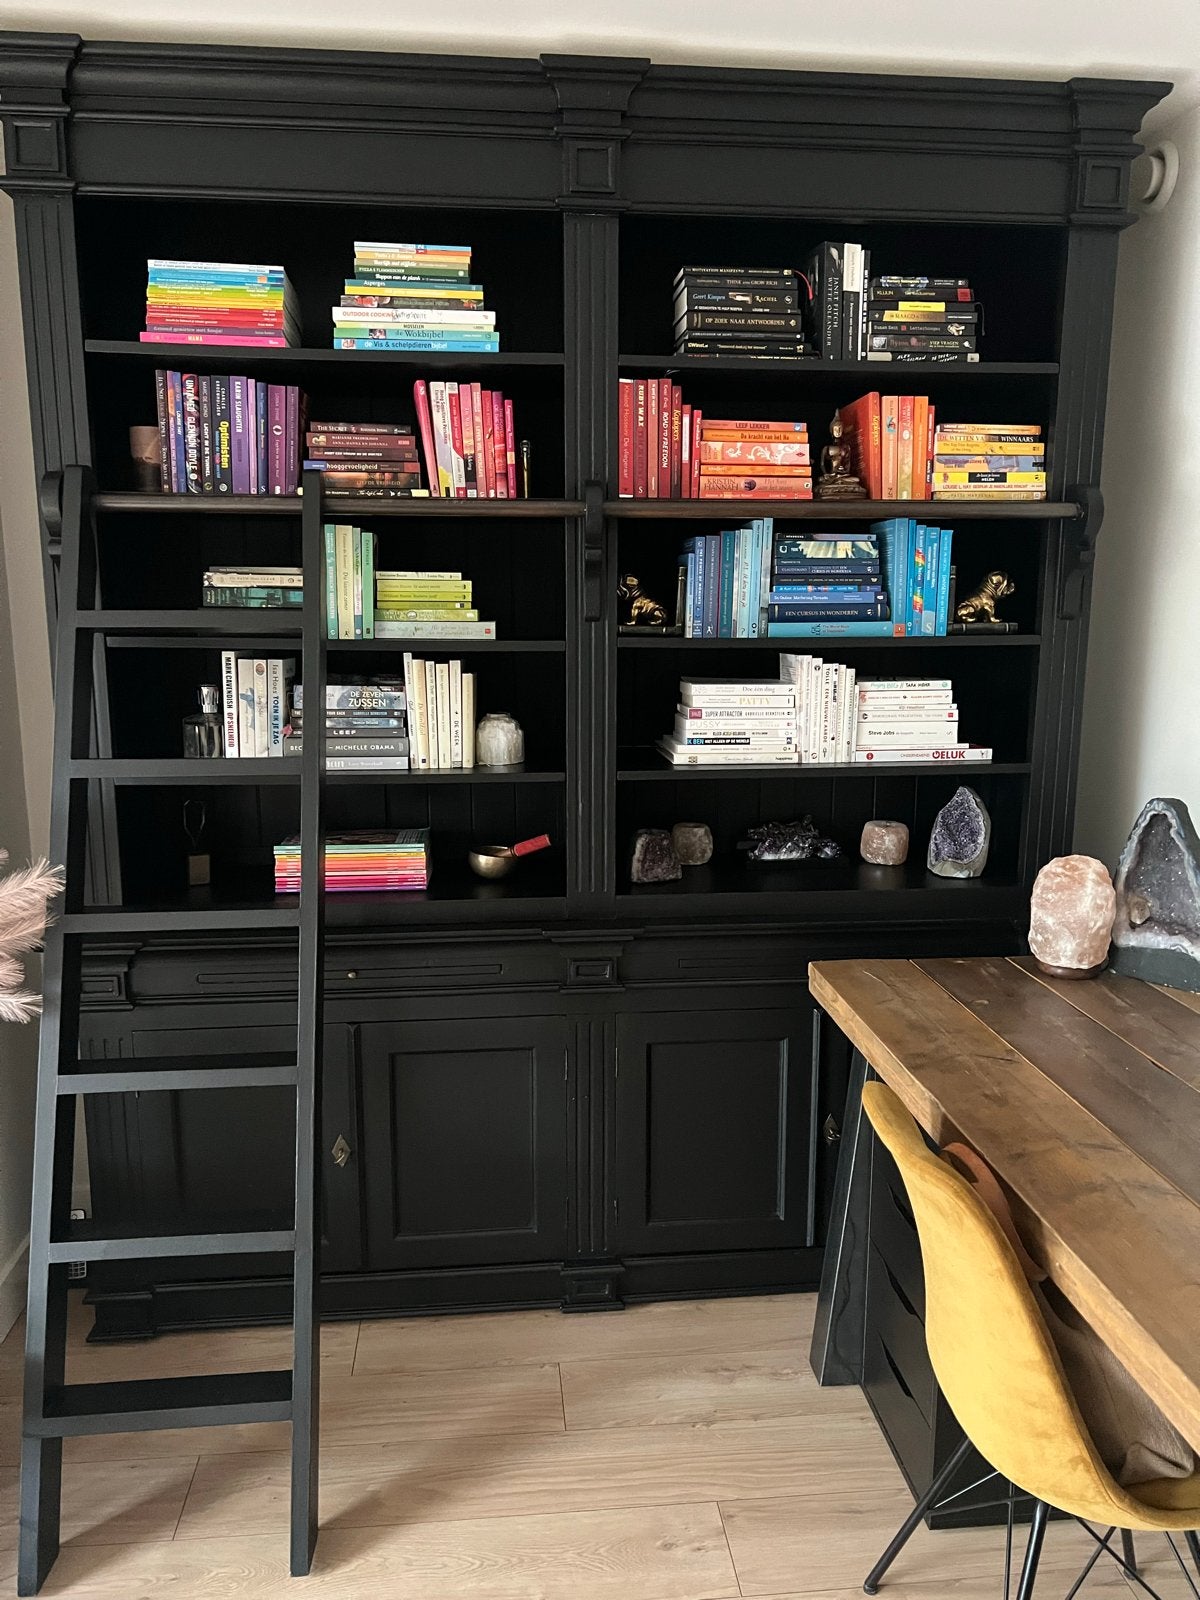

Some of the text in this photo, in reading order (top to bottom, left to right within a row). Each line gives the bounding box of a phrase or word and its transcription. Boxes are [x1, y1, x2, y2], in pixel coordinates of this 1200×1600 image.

[404, 330, 444, 339] Wokbijbel
[186, 380, 196, 411] UNTAMED
[672, 409, 680, 441] Koplopers
[187, 417, 197, 470] GLENNON DOYLE
[219, 421, 230, 468] Optimisten
[624, 438, 630, 447] De
[348, 698, 386, 707] ZUSSEN
[932, 751, 965, 759] GELUK
